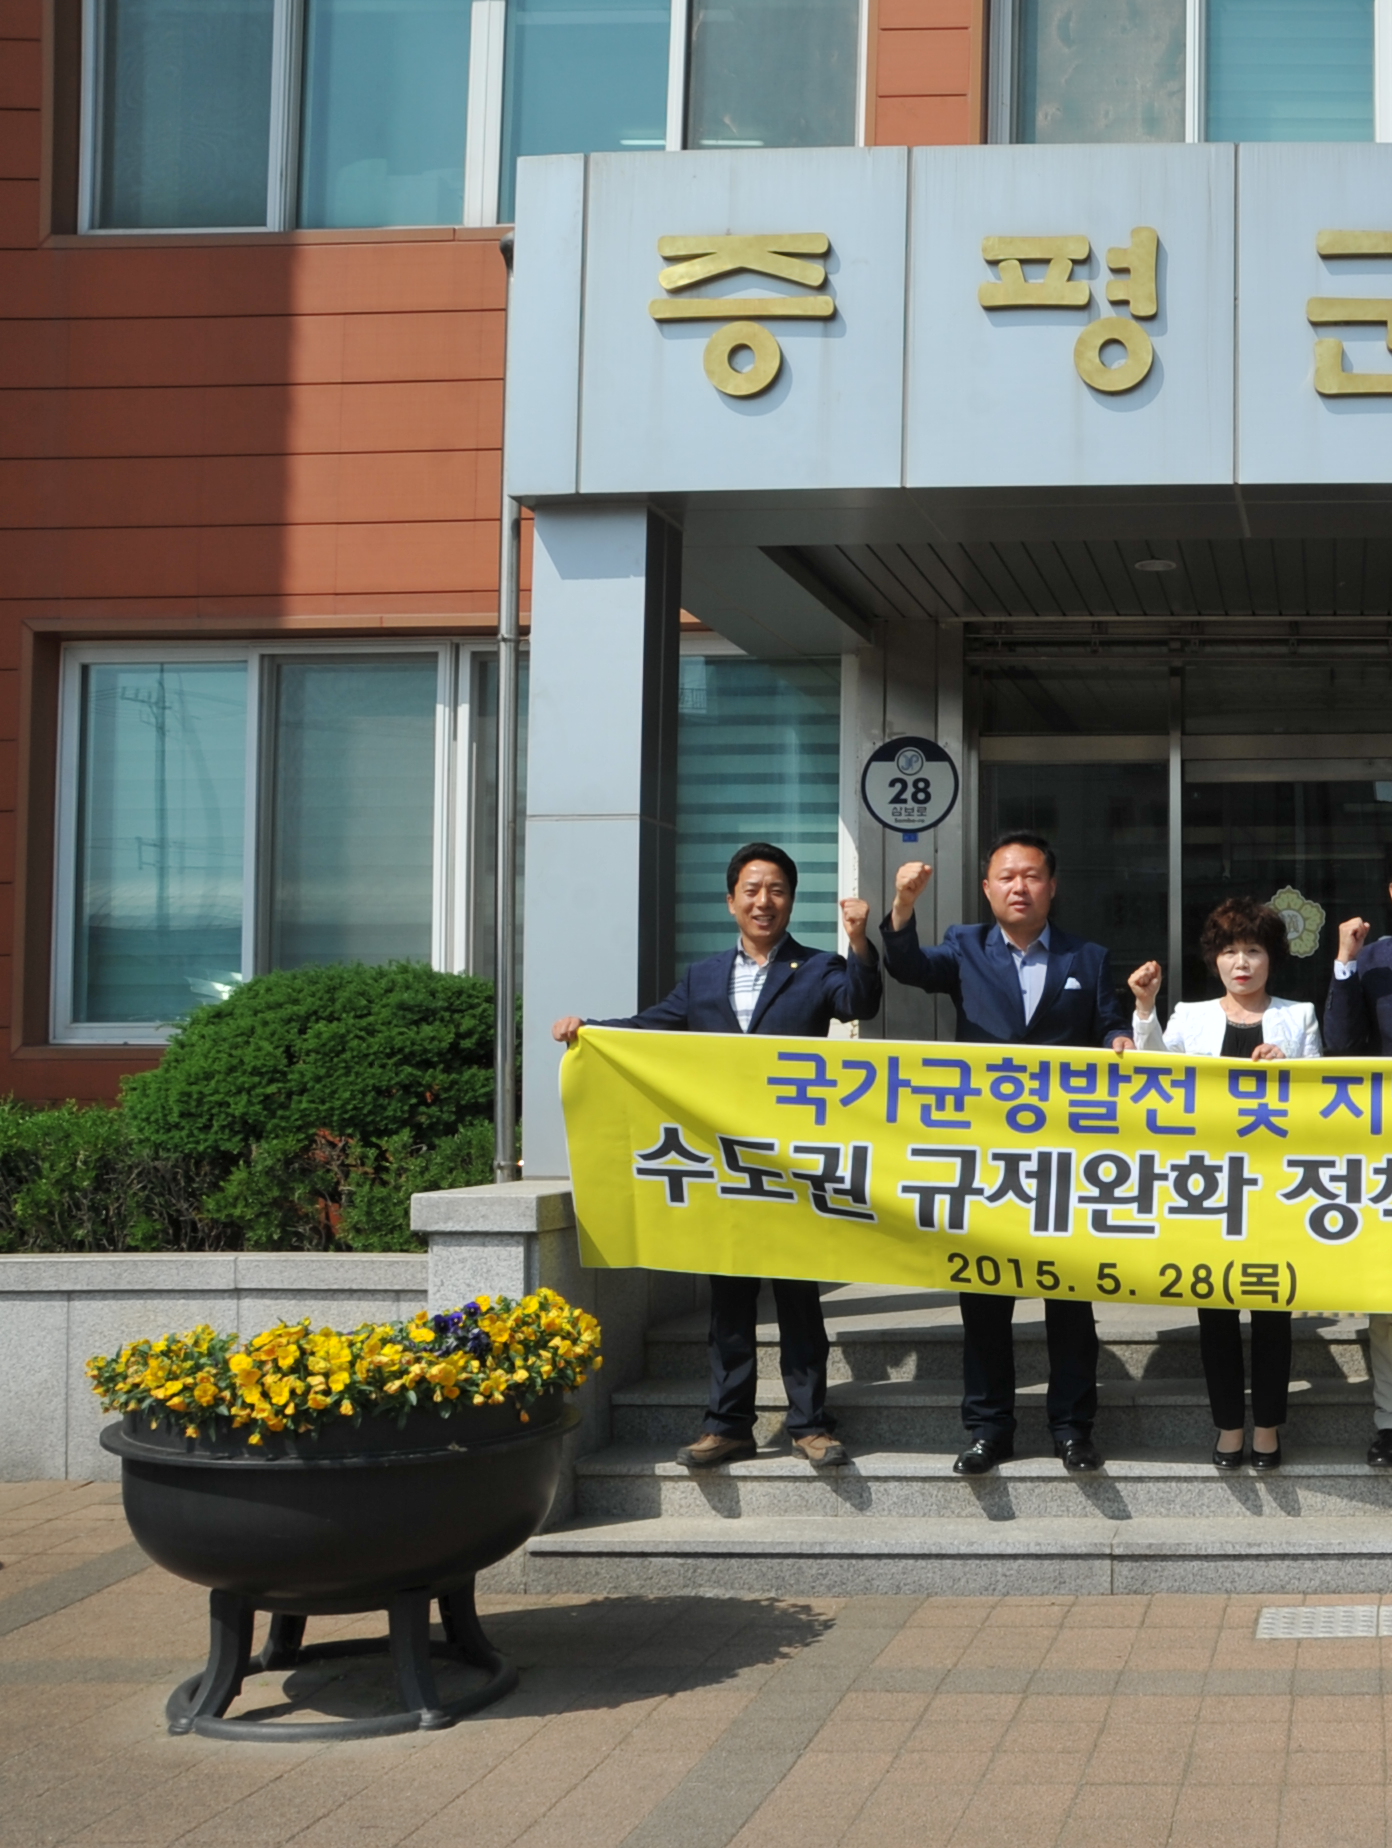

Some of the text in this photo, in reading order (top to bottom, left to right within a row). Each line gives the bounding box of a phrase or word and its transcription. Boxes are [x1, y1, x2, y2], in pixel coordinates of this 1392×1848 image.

[888, 777, 932, 805] 28
[891, 806, 927, 817] 삼보로
[767, 1051, 1196, 1137] 국가균형발전
[1227, 1069, 1291, 1139] 및
[634, 1125, 877, 1222] 수도권
[900, 1145, 1261, 1239] 규제완화
[947, 1252, 1297, 1306] 2015. 5. 28(목)
